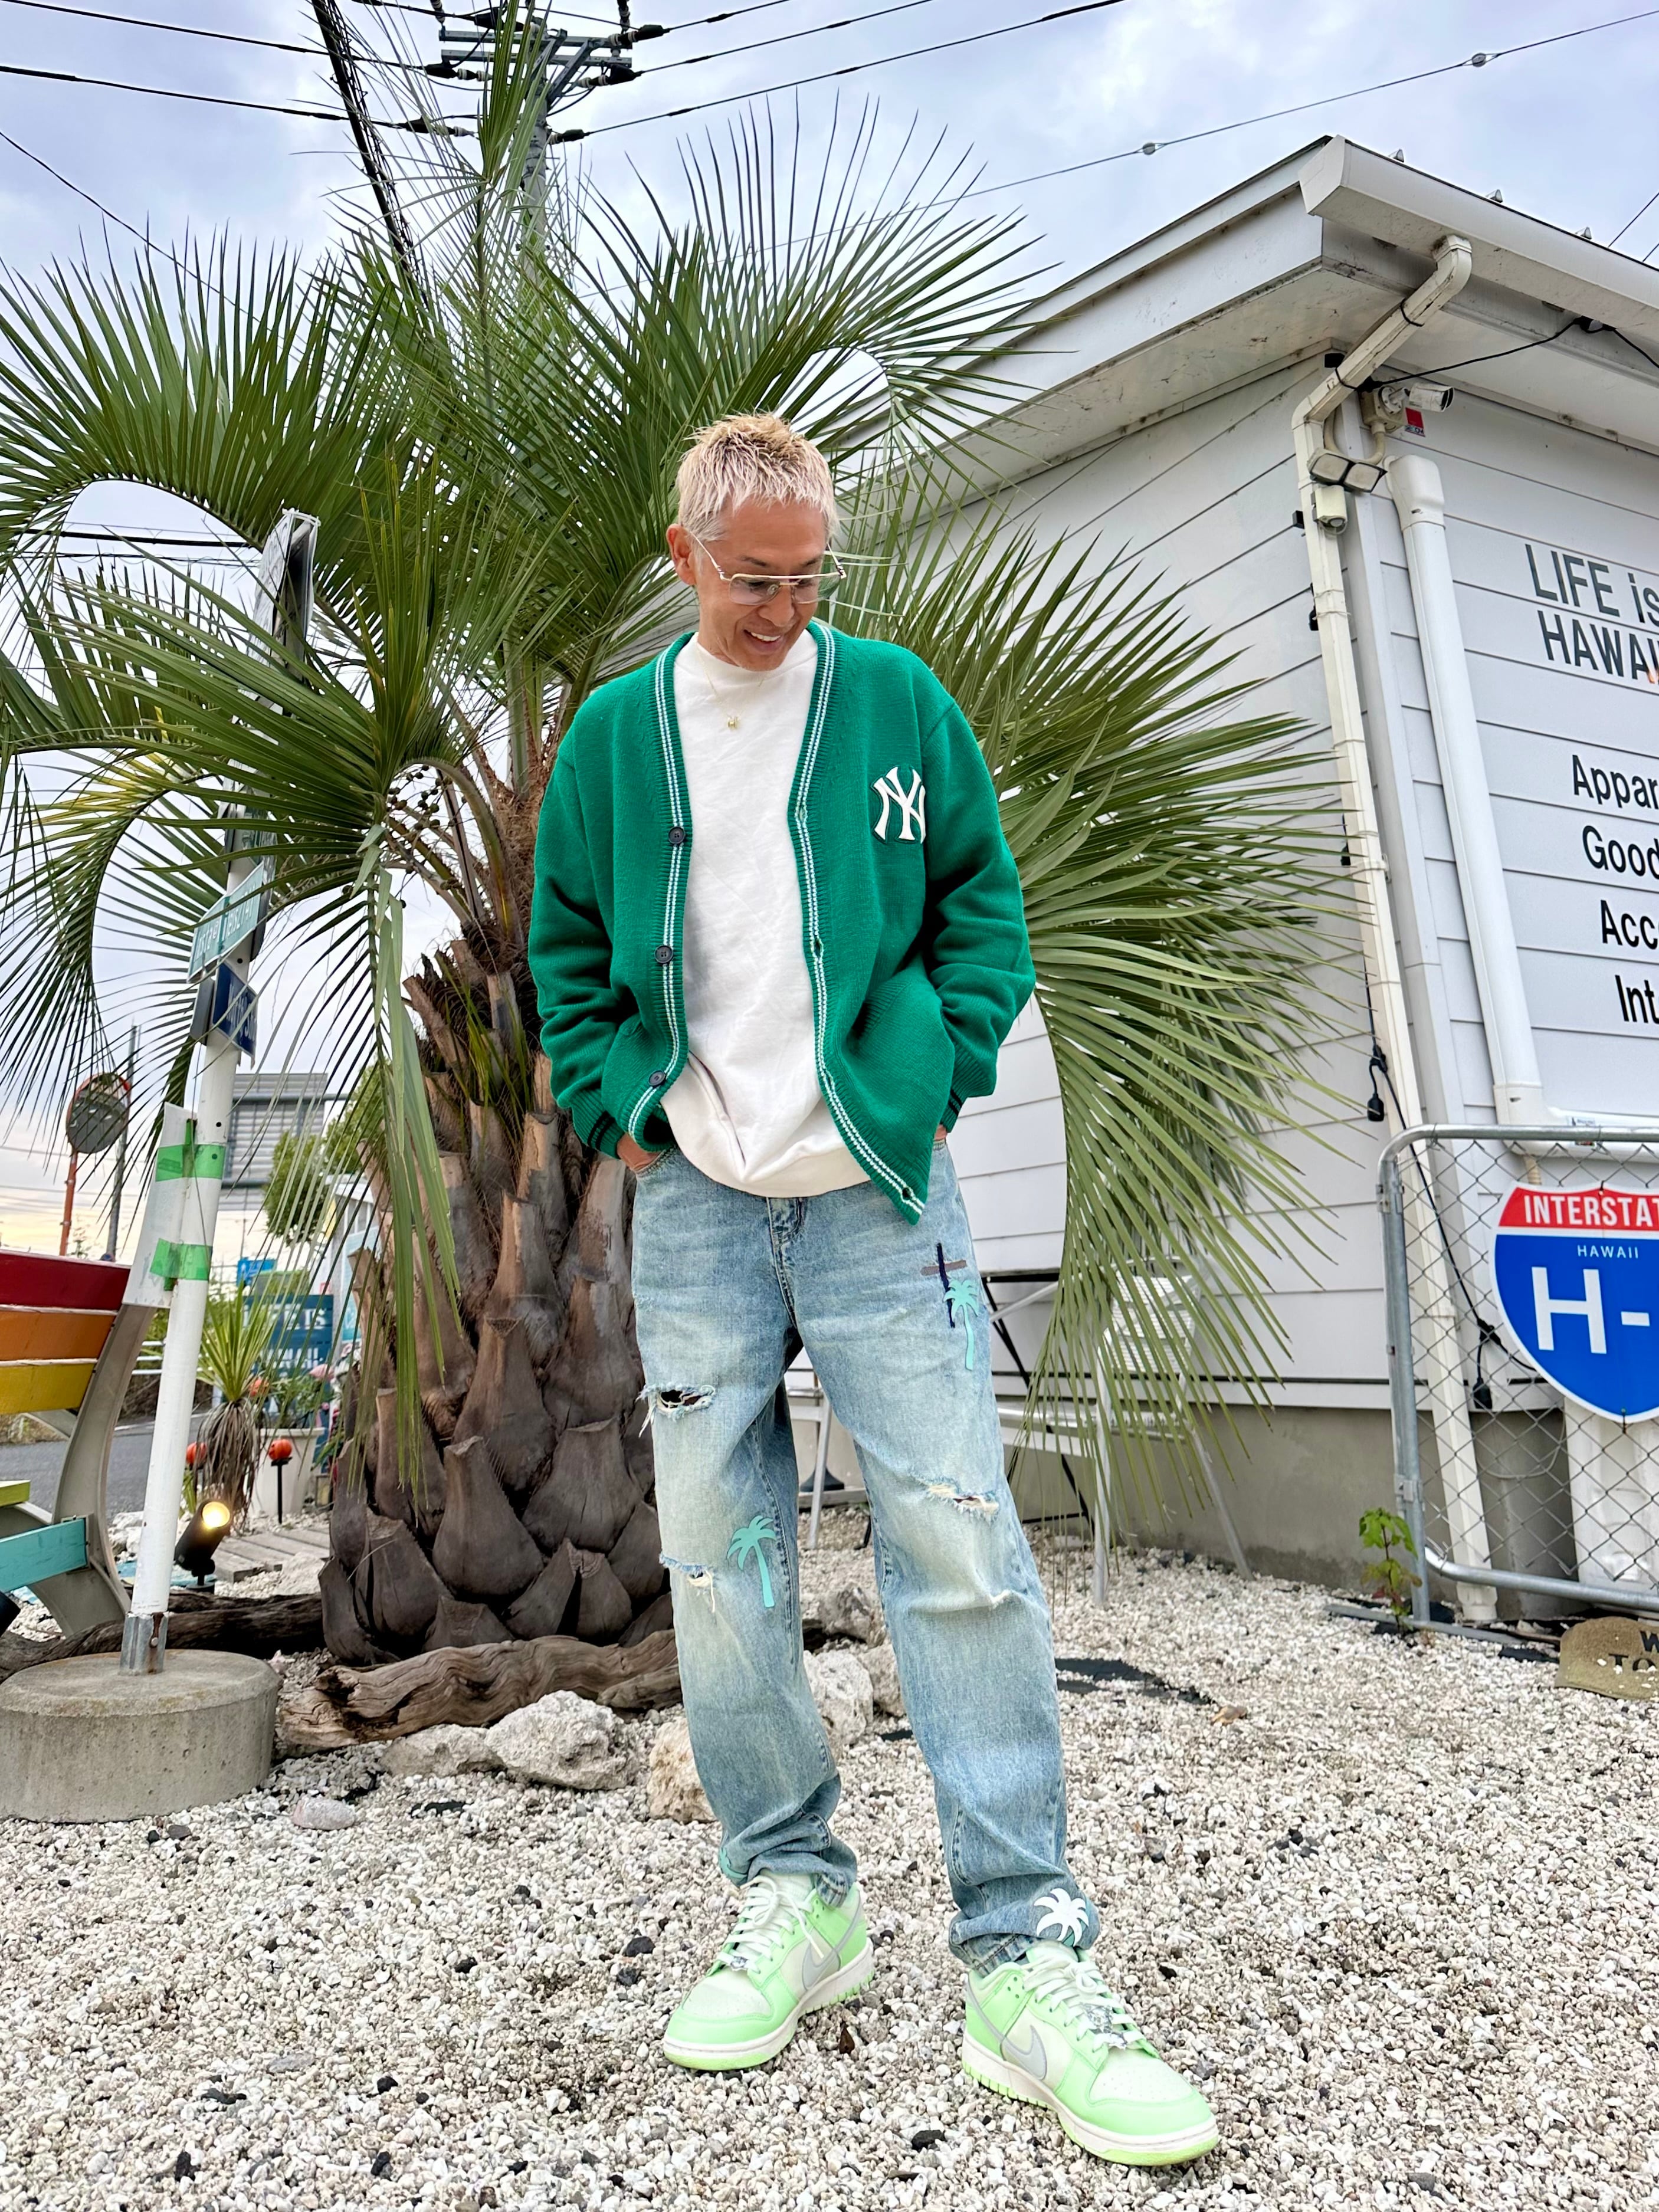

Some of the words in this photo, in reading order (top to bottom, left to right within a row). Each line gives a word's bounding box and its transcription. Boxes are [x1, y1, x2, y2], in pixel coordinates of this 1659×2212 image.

[1525, 543, 1621, 618] LIFE
[1537, 609, 1659, 685] HAWAI
[873, 766, 926, 844] NY
[1572, 754, 1659, 810] Appar
[1582, 825, 1659, 880] Good
[1600, 900, 1659, 950] Acc
[1577, 1245, 1638, 1259] HAWAII
[1532, 1266, 1650, 1354] H-
